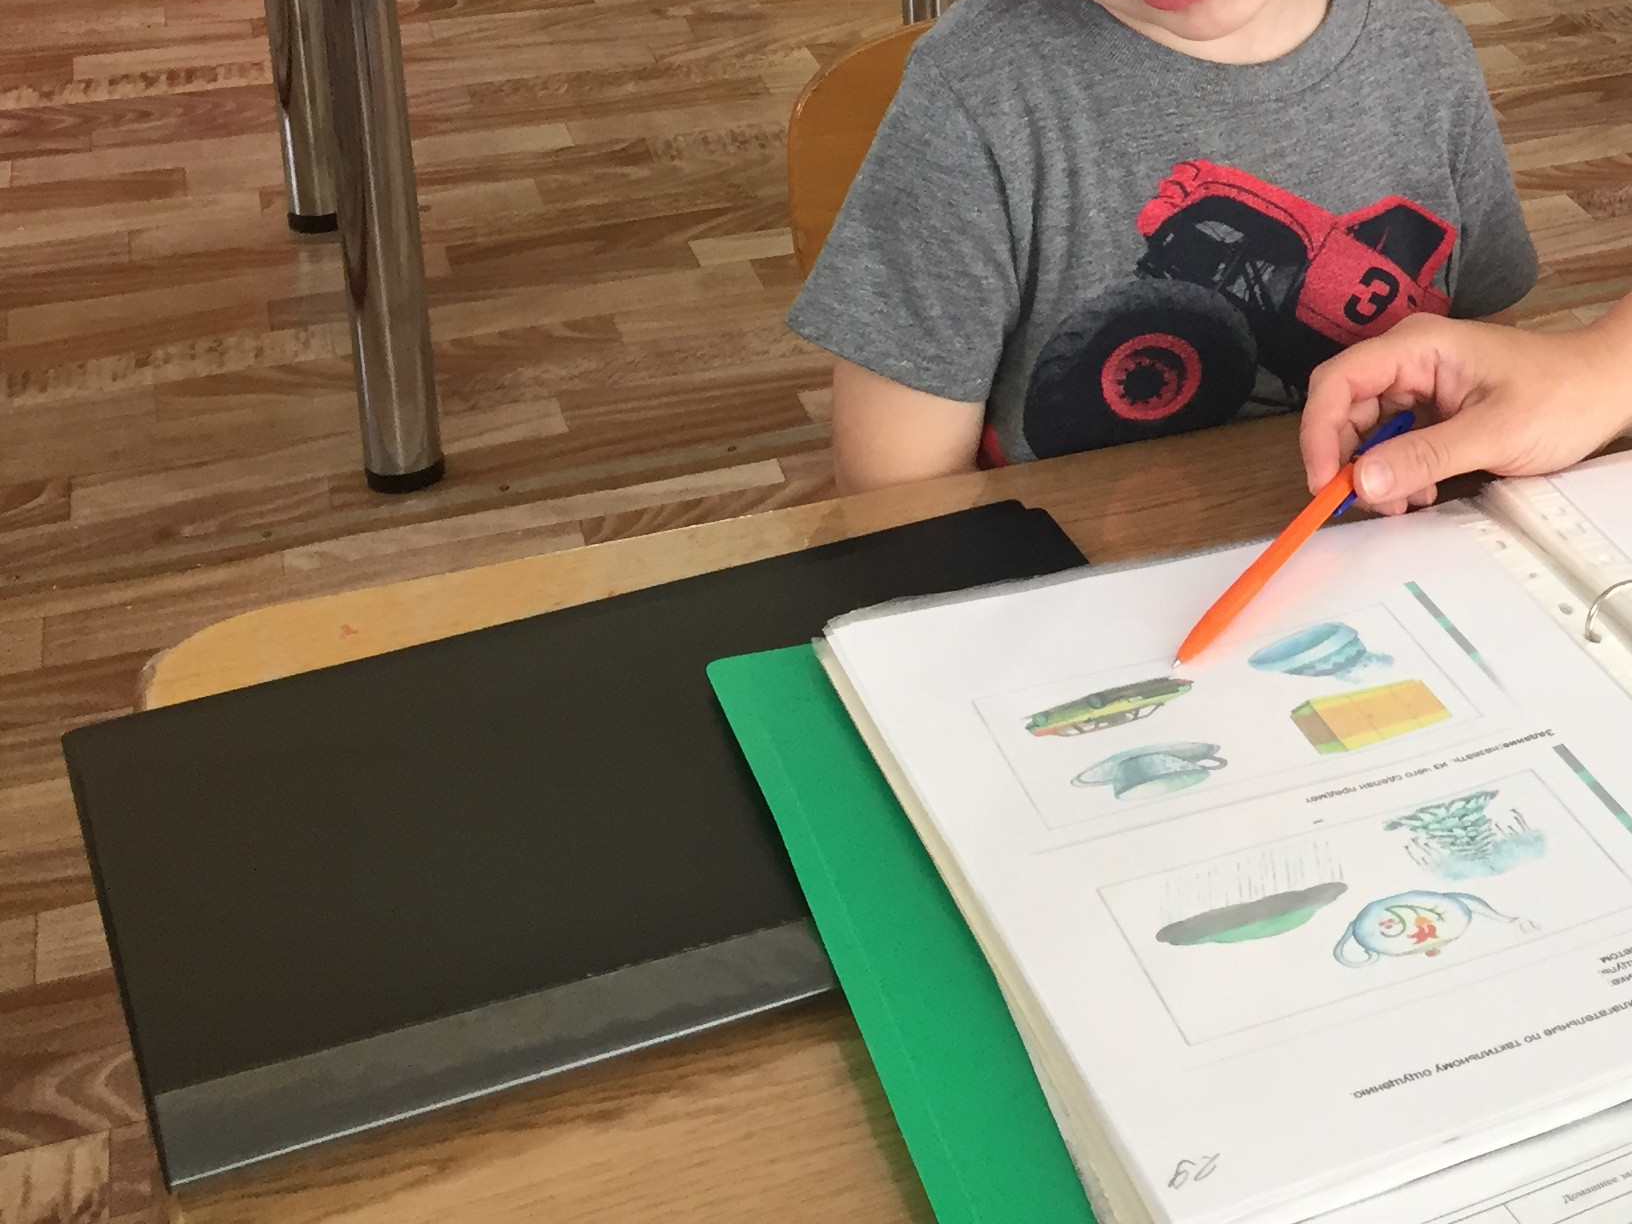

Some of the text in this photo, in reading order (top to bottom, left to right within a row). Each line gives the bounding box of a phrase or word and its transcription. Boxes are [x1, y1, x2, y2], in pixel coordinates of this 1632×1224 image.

[1343, 266, 1400, 326] 3
[1405, 765, 1431, 779] чего
[1433, 760, 1449, 771] из
[1358, 774, 1403, 792] сделан
[1305, 785, 1358, 804] предмет
[1523, 1030, 1542, 1043] по
[1435, 1038, 1522, 1074] тактильному
[1167, 1152, 1221, 1190] 29
[1561, 1176, 1619, 1206] Домашнее
